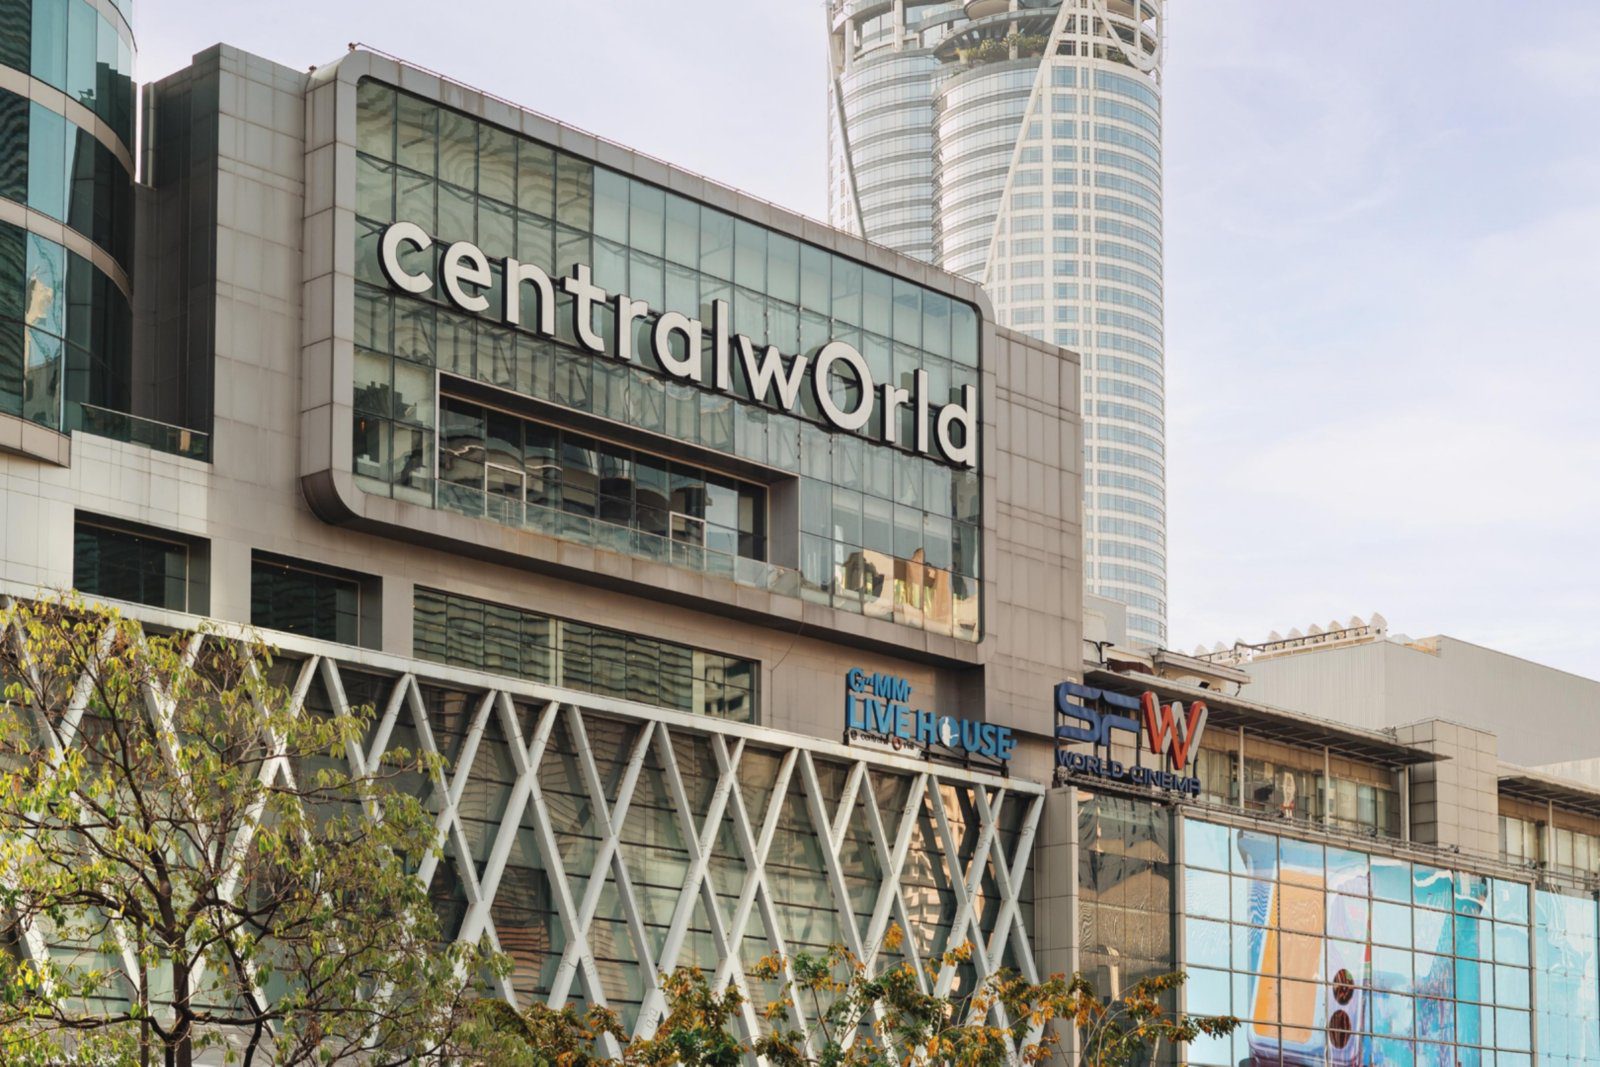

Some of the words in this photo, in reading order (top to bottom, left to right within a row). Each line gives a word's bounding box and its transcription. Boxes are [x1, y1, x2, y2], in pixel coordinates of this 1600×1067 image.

[378, 221, 978, 469] centralwOrld
[847, 695, 911, 740] LIVE
[1057, 749, 1124, 778] WORLD
[1131, 765, 1201, 795] CINEMA
